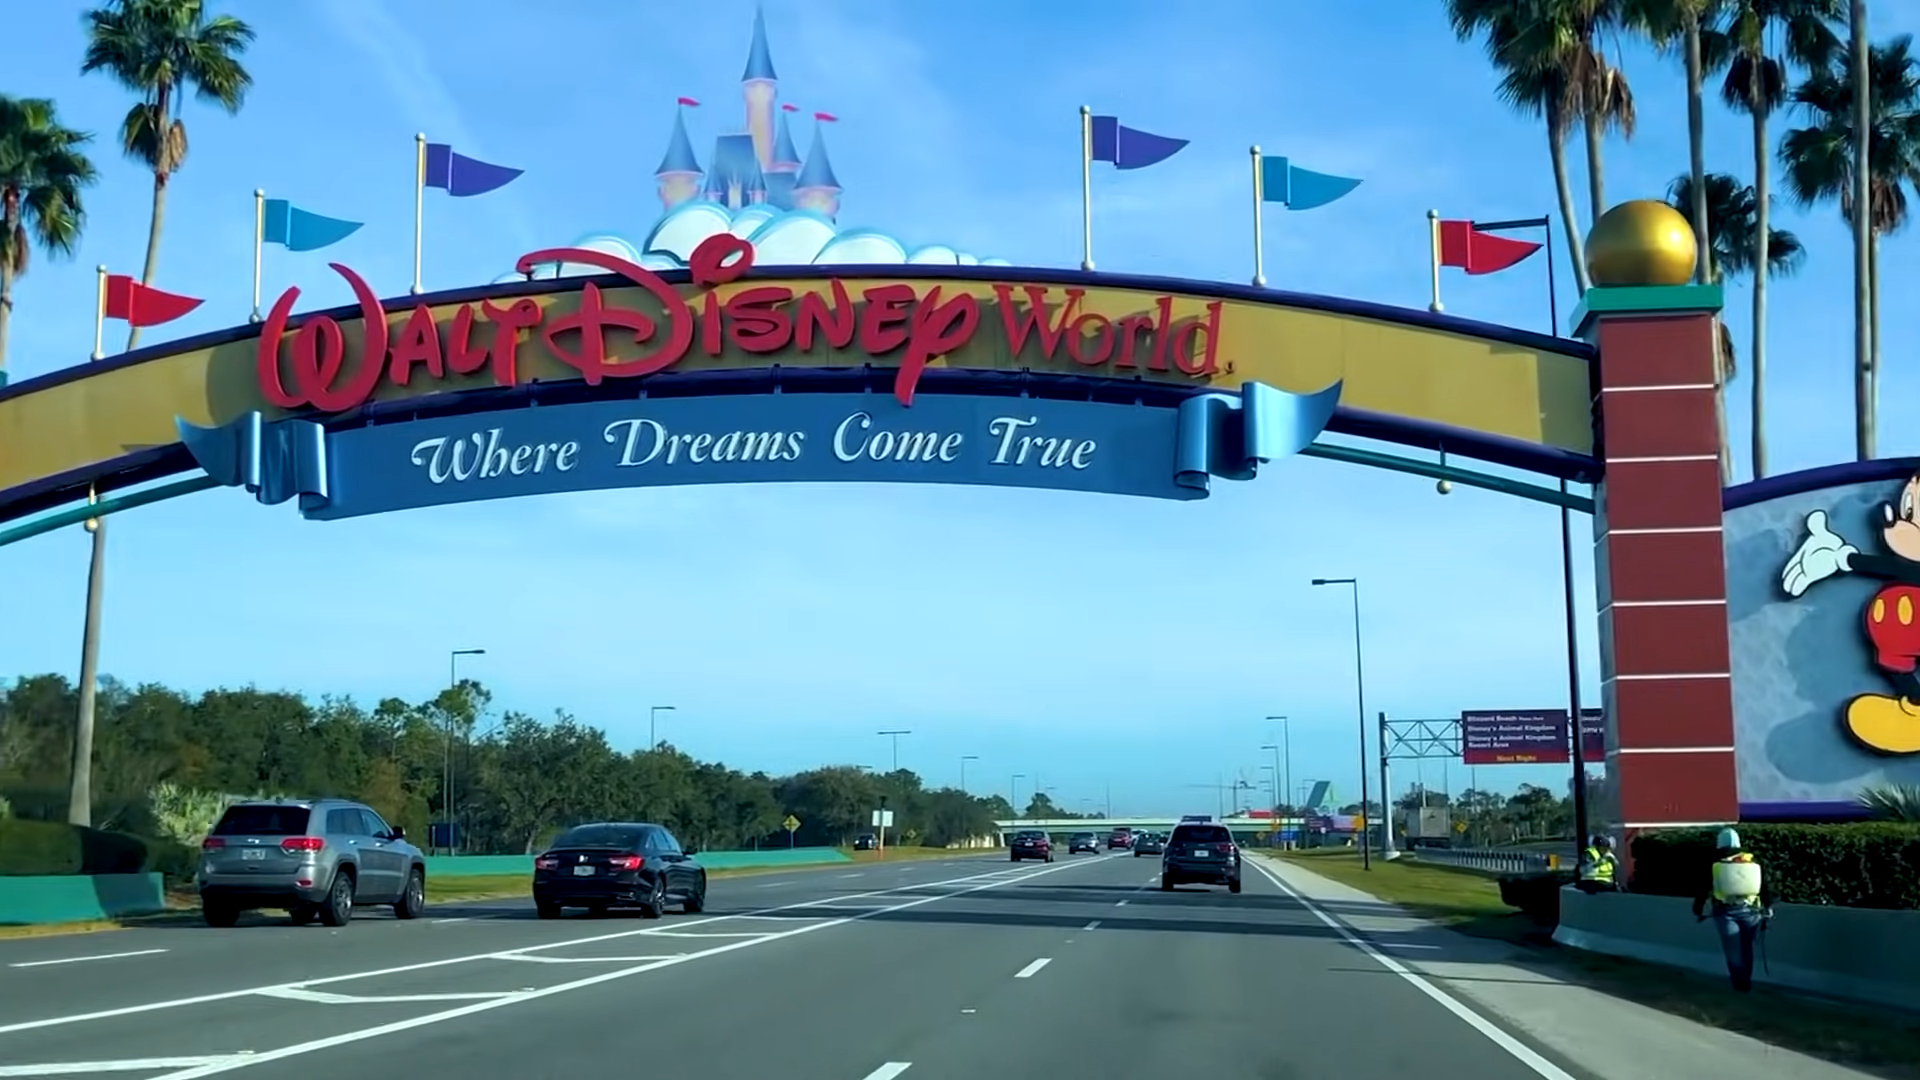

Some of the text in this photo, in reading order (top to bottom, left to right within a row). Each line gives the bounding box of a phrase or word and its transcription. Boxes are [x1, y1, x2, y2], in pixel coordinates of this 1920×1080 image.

[991, 284, 1223, 375] World
[411, 411, 1097, 485] Where Dreams Come True
[1525, 734, 1556, 742] Kingdom
